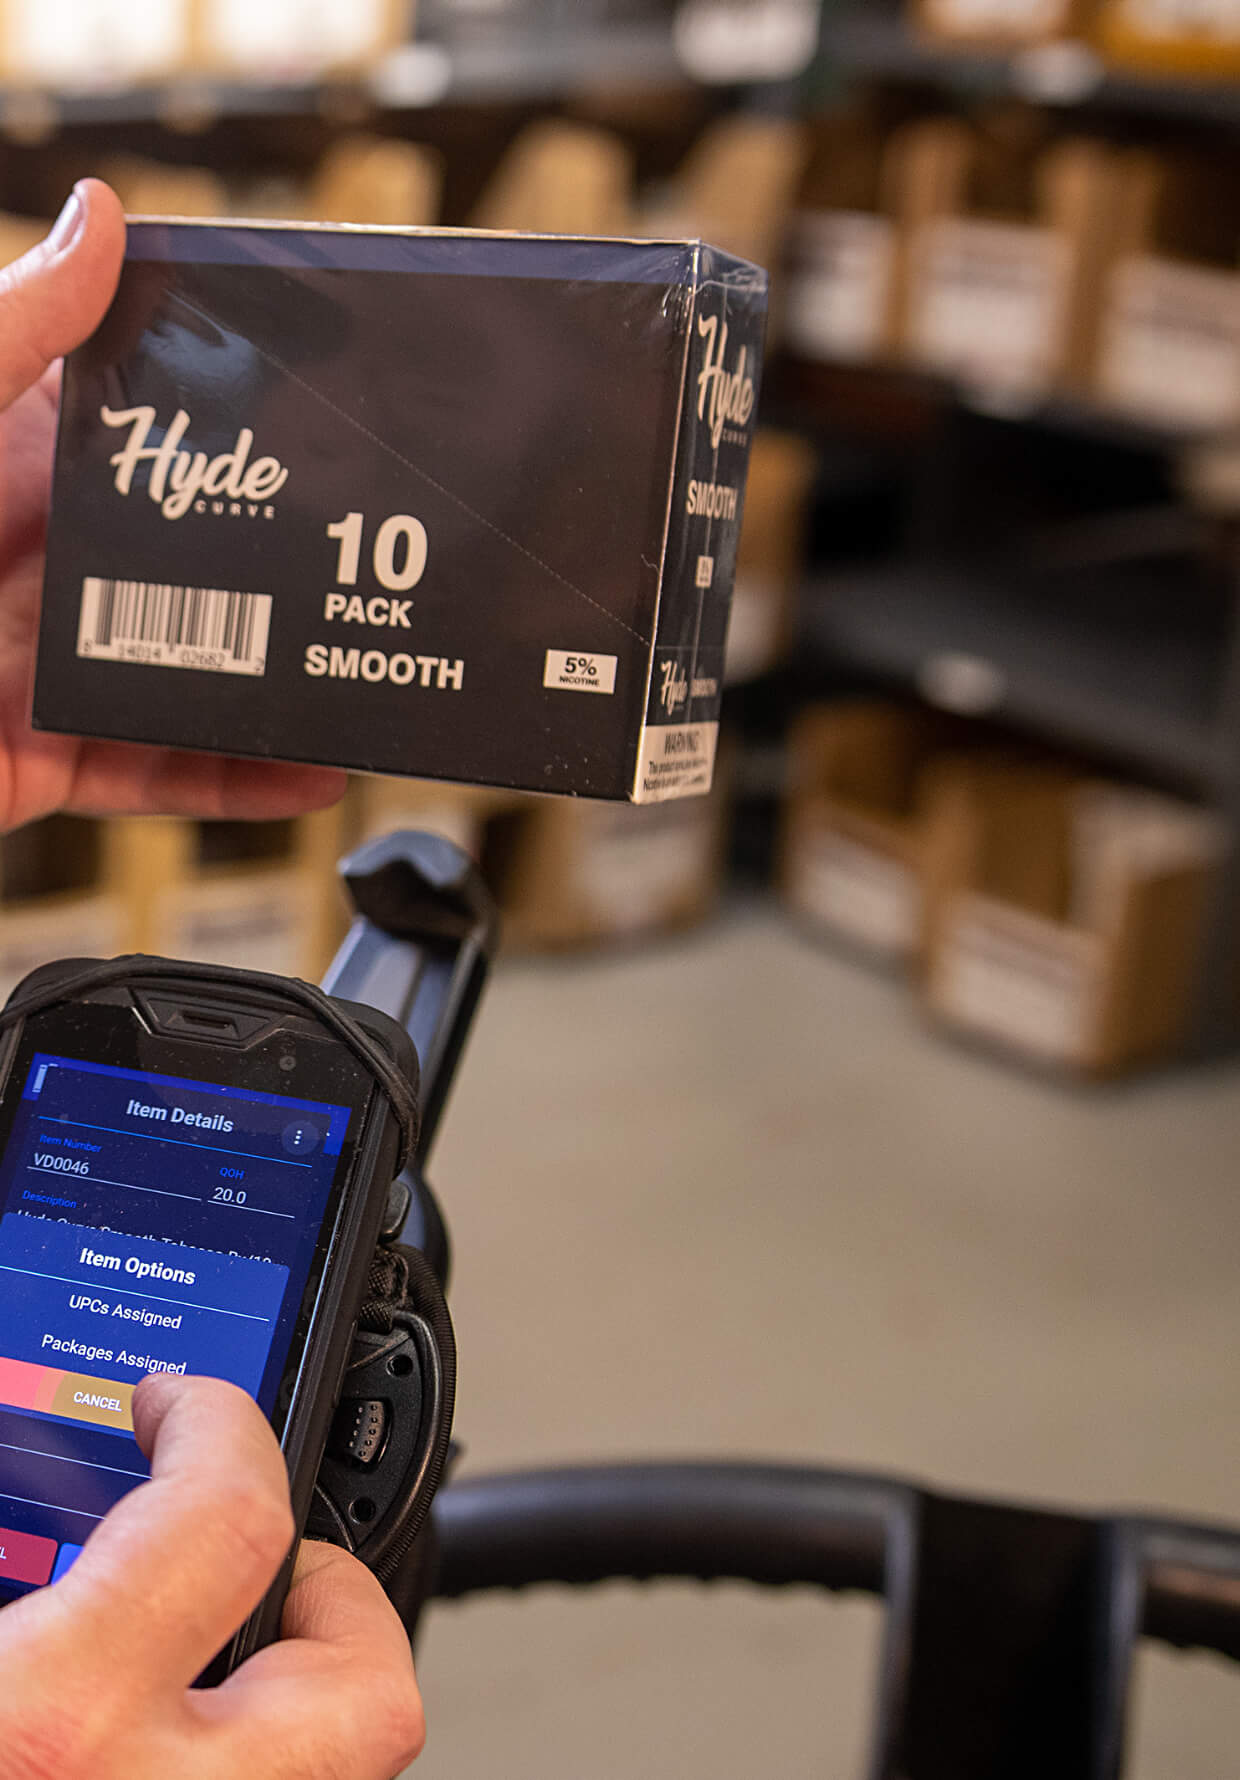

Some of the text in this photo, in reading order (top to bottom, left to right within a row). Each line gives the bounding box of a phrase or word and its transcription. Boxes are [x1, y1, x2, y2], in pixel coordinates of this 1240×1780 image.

[698, 312, 754, 449] Hyde
[101, 405, 288, 520] Hyde
[194, 500, 275, 520] CURVE
[686, 480, 738, 520] SMOOTH
[327, 512, 428, 591] 10
[324, 592, 414, 628] PACK
[118, 643, 162, 662] 14014
[565, 656, 598, 676] 5%
[304, 643, 464, 691] SMOOTH
[559, 675, 600, 688] NICOTINE
[126, 1099, 234, 1133] Item Details
[40, 1134, 102, 1152] Item Number
[34, 1153, 90, 1175] VD0046
[219, 1167, 245, 1180] QOH
[22, 1190, 77, 1209] Description
[213, 1186, 247, 1204] 20.0
[79, 1248, 196, 1285] Item Options
[69, 1294, 182, 1329] UPCs Assigned
[41, 1334, 187, 1376] Packages Assigned
[73, 1391, 123, 1412] CANCEL
